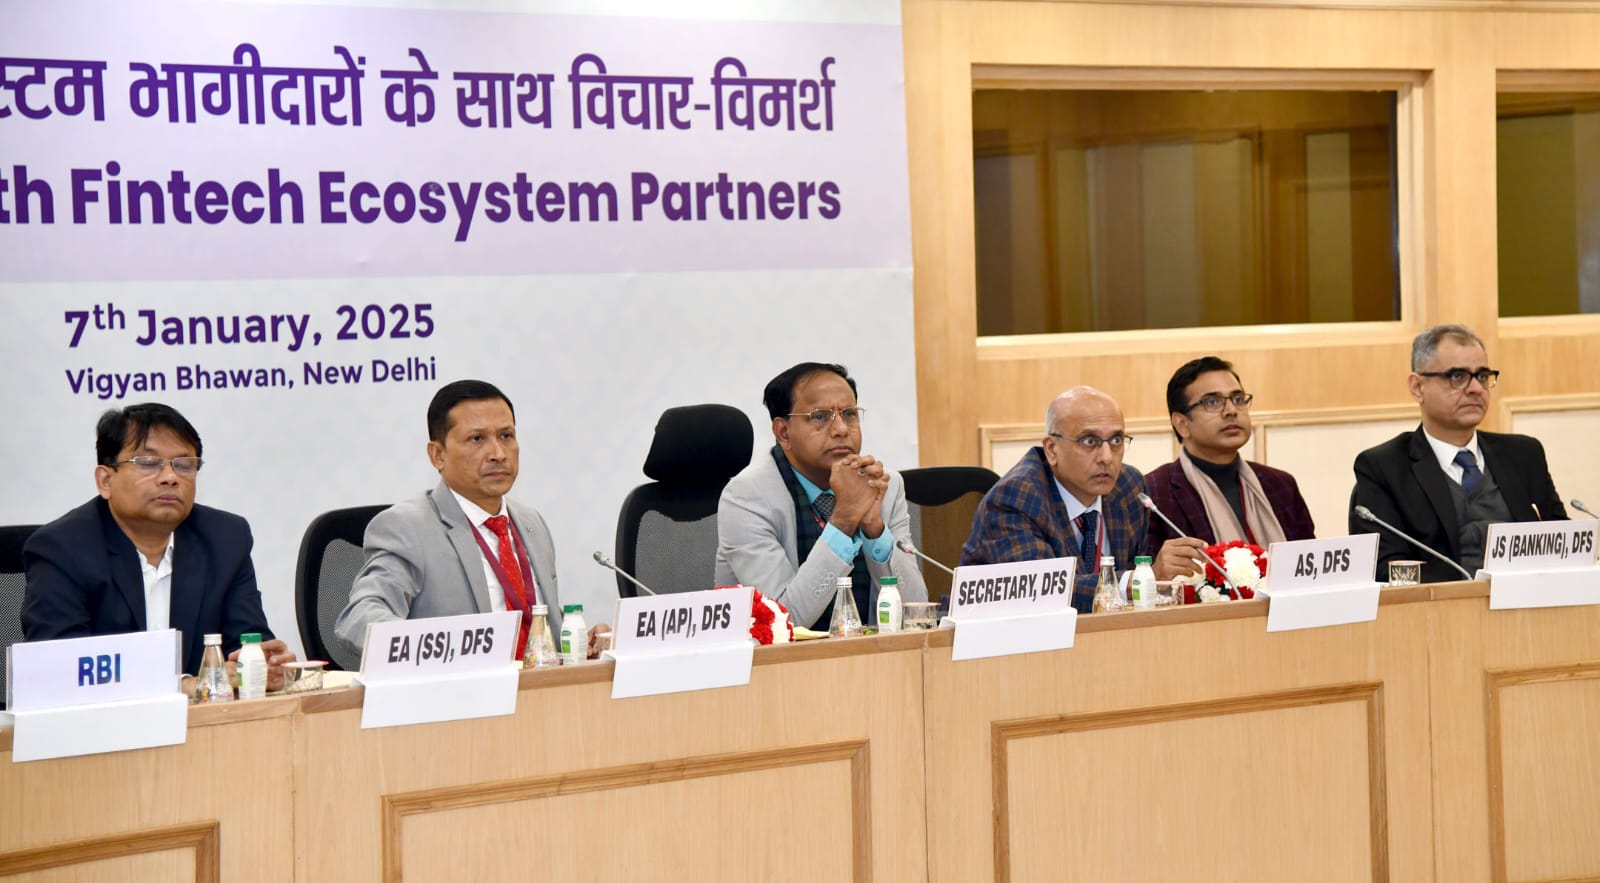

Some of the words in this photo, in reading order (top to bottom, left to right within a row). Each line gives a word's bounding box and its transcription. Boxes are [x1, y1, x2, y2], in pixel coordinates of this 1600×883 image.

[129, 43, 366, 127] भागीदारों
[380, 48, 438, 127] के
[453, 72, 554, 129] साथ
[568, 53, 836, 131] विचार-विमर्श
[71, 161, 304, 225] Fintech
[319, 170, 618, 242] Ecosystem
[631, 172, 841, 221] Partners
[64, 303, 126, 348] 7th
[136, 310, 322, 352] January,
[336, 304, 435, 340] 2025
[66, 368, 166, 400] Vigyan
[176, 363, 295, 391] Bhawan,
[303, 361, 363, 386] New
[372, 355, 436, 382] Delhi
[1294, 553, 1318, 580] AS,
[1322, 548, 1351, 574] DFS
[1491, 535, 1506, 559] JS
[1508, 532, 1569, 562] (BANKING),
[1571, 530, 1594, 554] DFS
[957, 573, 1037, 606] SECRETARY,
[1041, 570, 1068, 596] DFS
[636, 611, 656, 638] EA
[661, 607, 697, 640] (AP),
[701, 602, 732, 631] DFS
[388, 636, 410, 663] EA
[416, 631, 455, 666] (SS),
[460, 627, 495, 656] DFS
[78, 653, 121, 687] RBI
